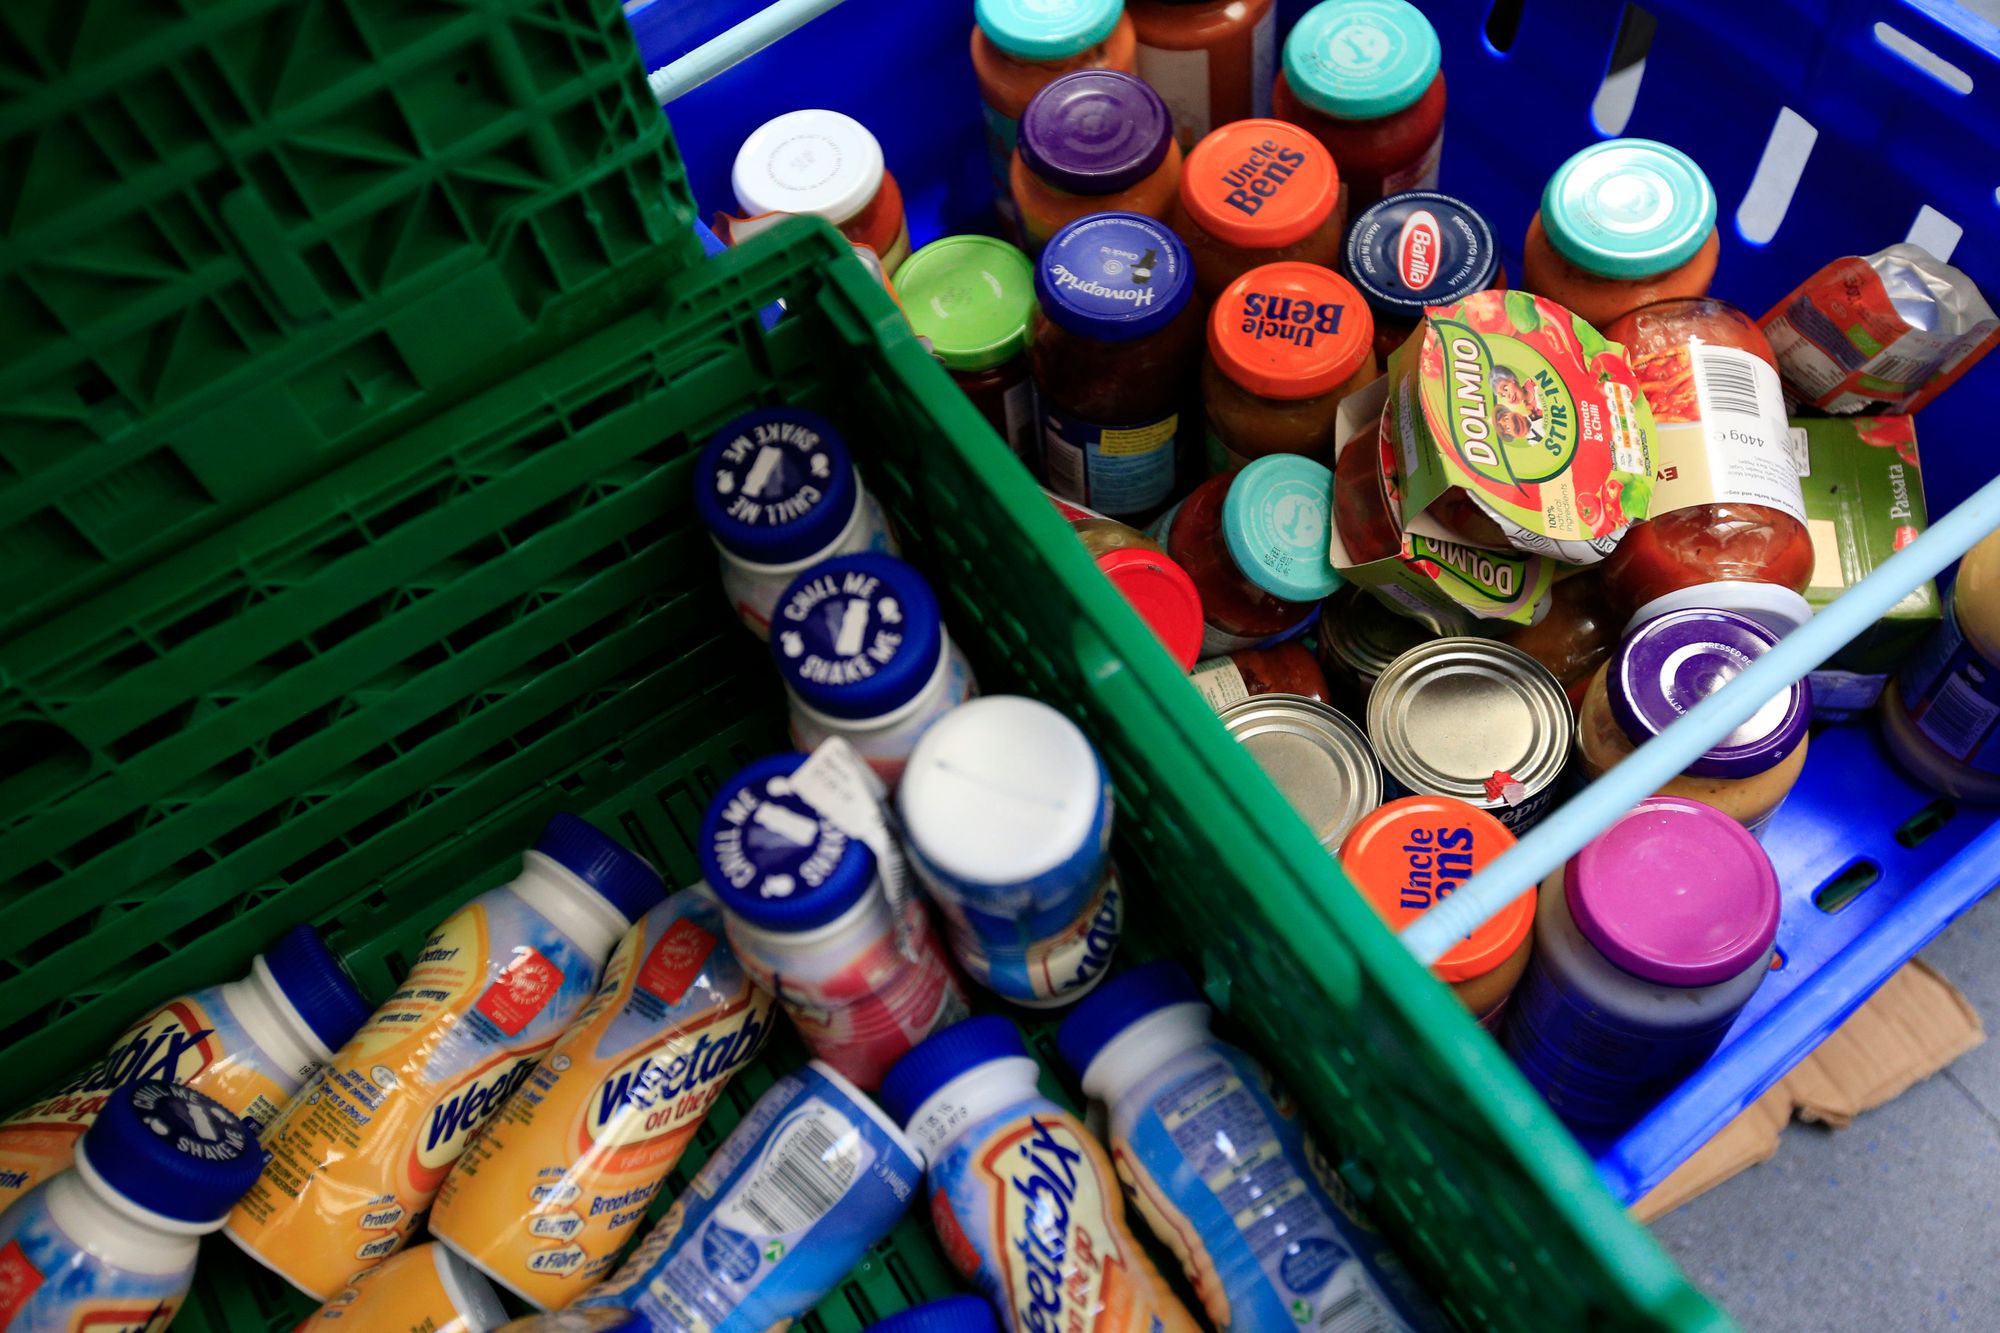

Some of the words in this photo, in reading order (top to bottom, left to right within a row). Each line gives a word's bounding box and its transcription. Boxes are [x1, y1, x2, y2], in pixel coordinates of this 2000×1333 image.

[1221, 139, 1278, 188] Uncle
[1361, 246, 1370, 255] IN
[1362, 222, 1381, 247] MADE
[1452, 215, 1478, 255] PRODOTTO
[1361, 255, 1376, 274] ITALY
[1409, 229, 1432, 284] Barilla
[1050, 264, 1155, 306] Homepride
[1448, 264, 1471, 285] ITALIA
[1241, 316, 1315, 347] Uncle
[1452, 338, 1499, 466] DOLMIO
[1534, 369, 1568, 457] STIR-IN
[1591, 404, 1603, 431] Chilli
[754, 422, 820, 451] SHAKE
[1583, 400, 1595, 441] Tomato
[1595, 432, 1603, 442] &
[722, 435, 754, 464] ME
[1730, 430, 1764, 447] 440g
[727, 495, 763, 524] ME
[765, 485, 822, 525] CHILL
[1563, 483, 1574, 533] ingredients
[1889, 464, 1912, 520] Passata
[1547, 505, 1557, 530] 100%
[1556, 498, 1565, 531] natural
[784, 574, 839, 622] CHILL
[843, 571, 880, 599] ME
[800, 653, 876, 685] SHAKE
[866, 629, 903, 664] ME
[721, 787, 760, 826] ME
[714, 827, 757, 889] CHILL
[1400, 828, 1433, 910] Uncle
[1435, 827, 1474, 901] en's
[416, 990, 450, 1001] energy
[132, 1085, 170, 1110] CHILL
[172, 1084, 200, 1105] ME
[645, 1105, 669, 1131] on
[674, 1093, 704, 1120] the
[177, 1137, 237, 1162] SHAKE
[226, 1130, 245, 1151] ME
[589, 1182, 653, 1217] Breakfast
[362, 1210, 401, 1228] Protein
[1012, 1116, 1082, 1333] eetabix
[360, 1237, 396, 1257] Energy
[532, 1256, 544, 1269] &
[544, 1252, 582, 1269] Fibre
[1075, 1225, 1099, 1271] go
